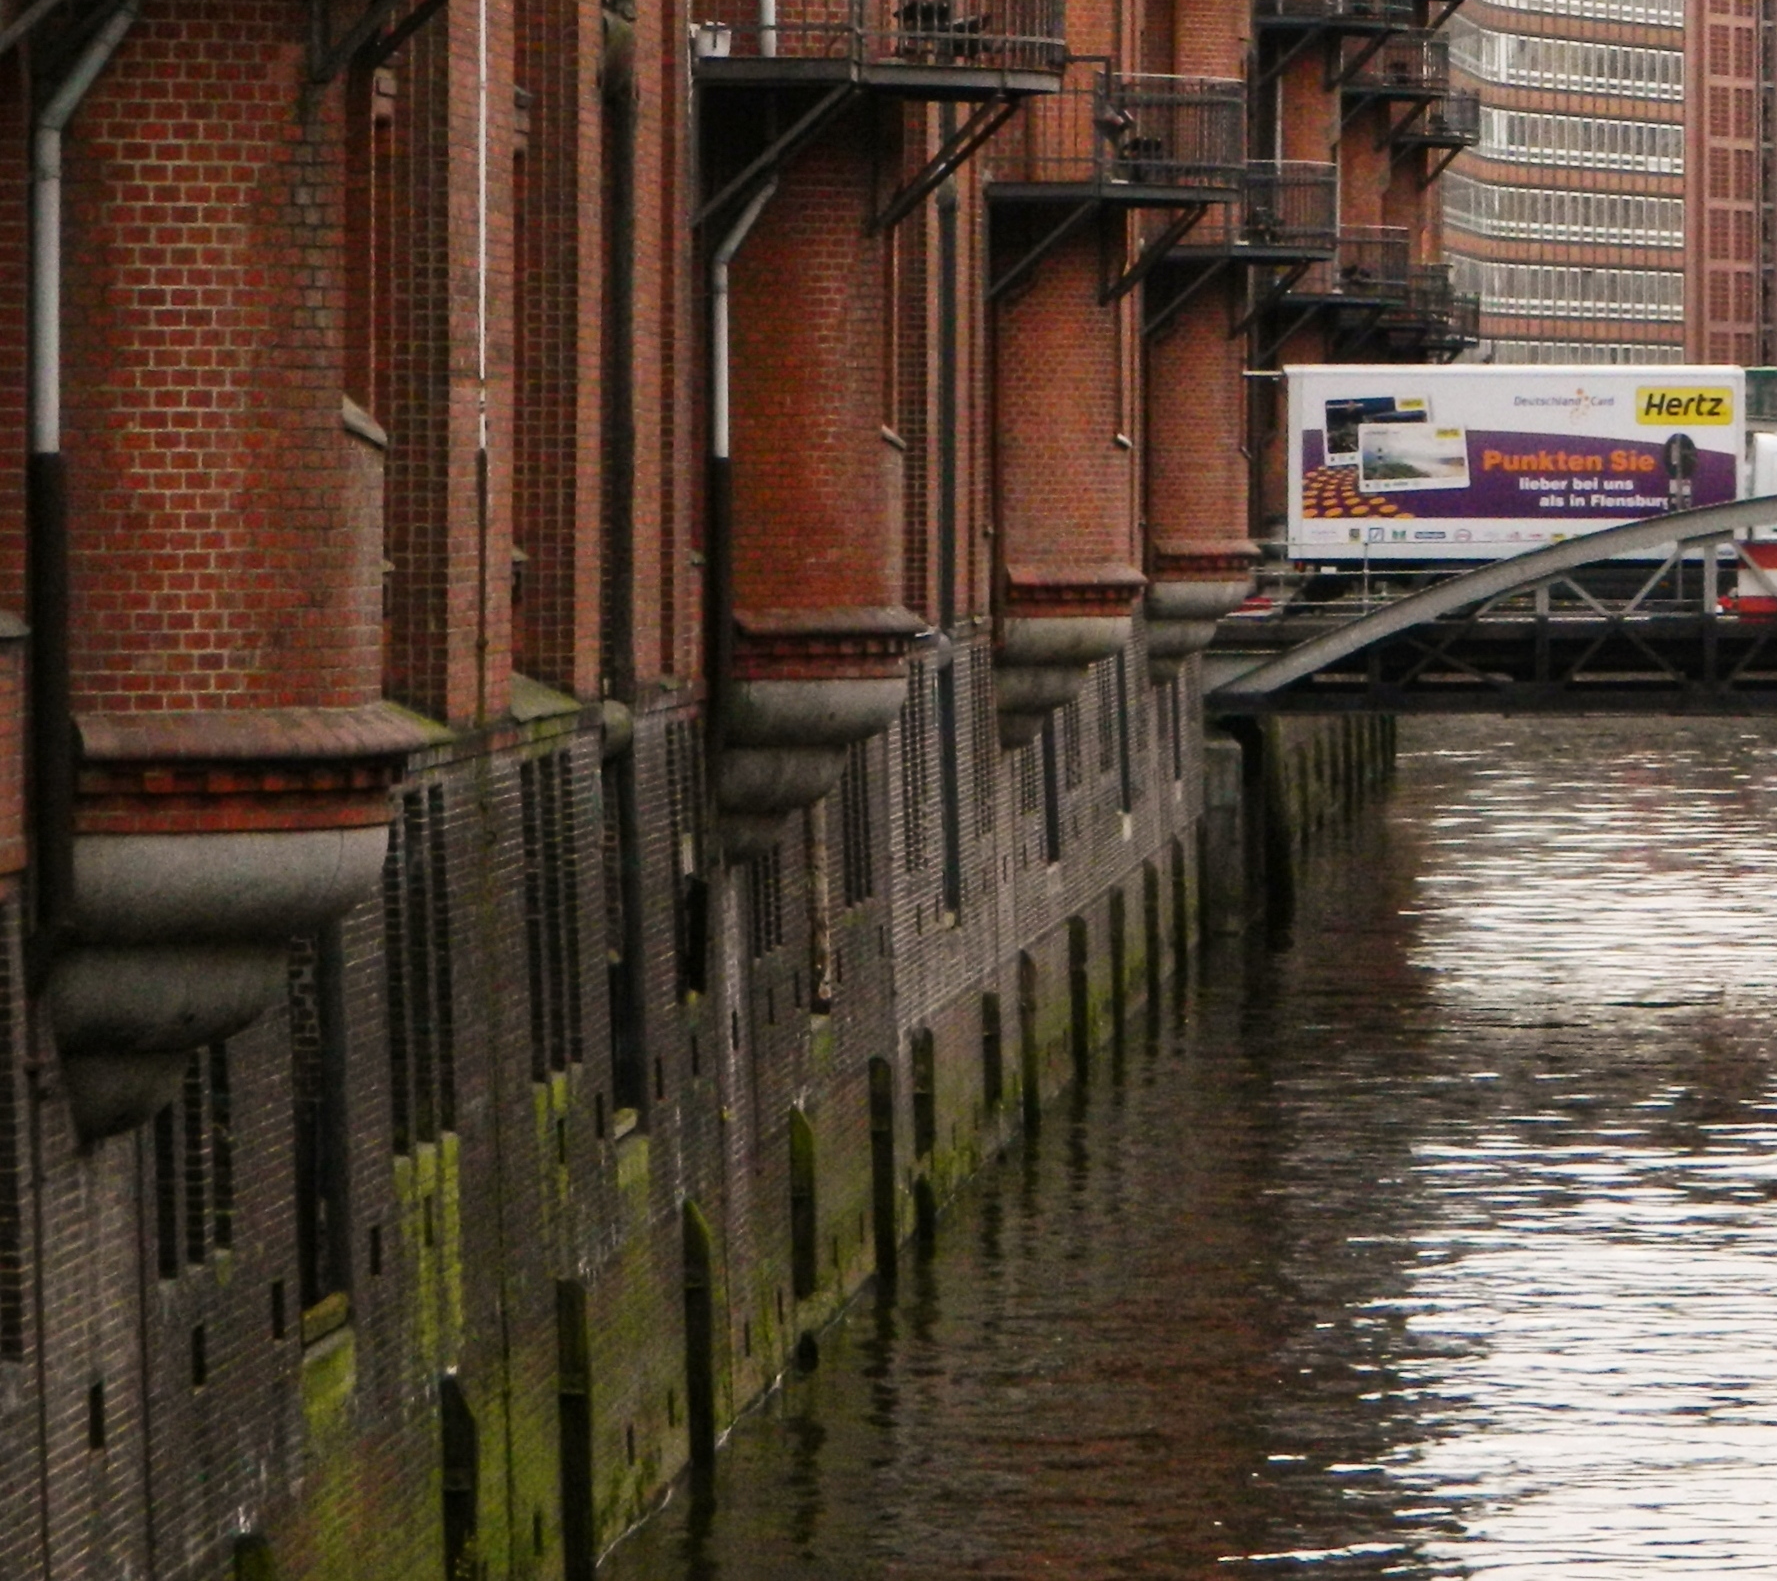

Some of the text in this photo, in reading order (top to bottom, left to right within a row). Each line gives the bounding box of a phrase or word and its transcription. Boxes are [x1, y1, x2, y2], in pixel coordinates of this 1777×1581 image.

[1644, 393, 1724, 417] Hertz
[1483, 450, 1656, 472] Punkten Sie
[1519, 477, 1634, 491] lieber bei uns
[1539, 494, 1564, 508] als
[1569, 494, 1586, 508] in
